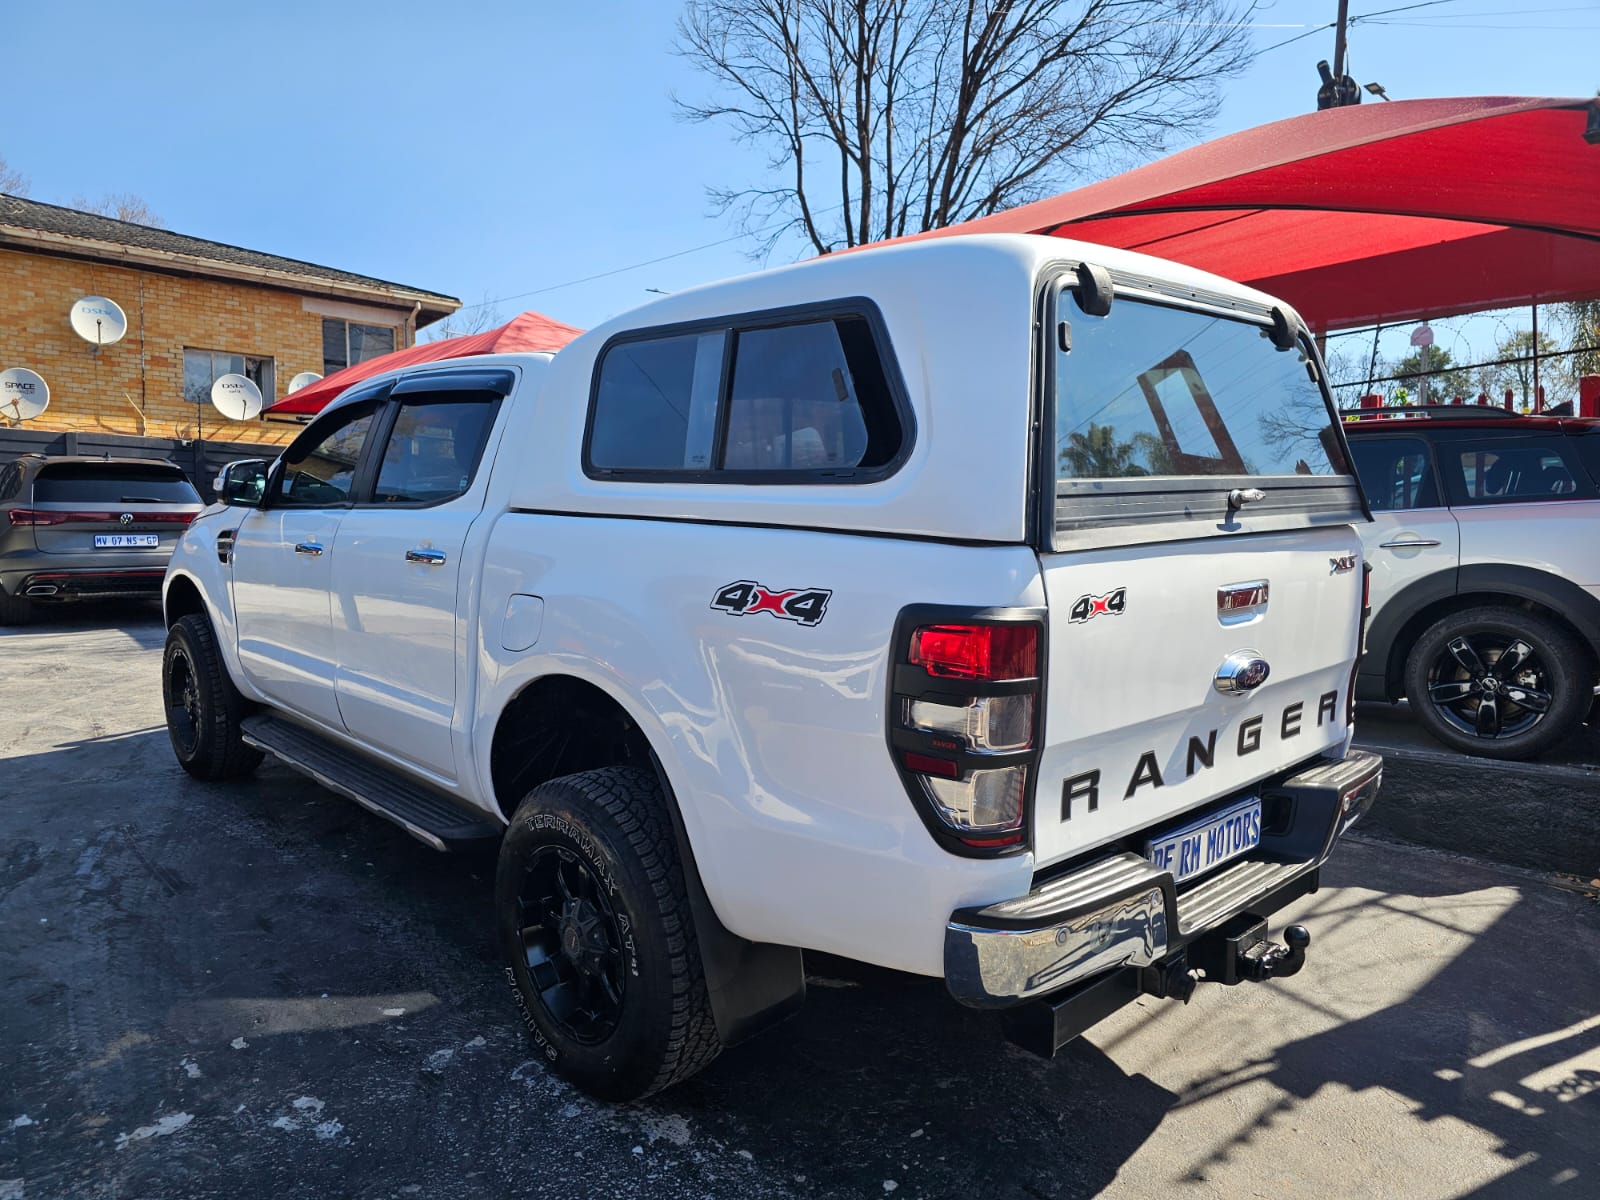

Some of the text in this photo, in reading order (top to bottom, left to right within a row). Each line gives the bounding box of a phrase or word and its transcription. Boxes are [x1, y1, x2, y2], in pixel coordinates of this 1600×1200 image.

[4, 381, 36, 390] SPACE
[1060, 689, 1338, 823] RANGER
[525, 814, 619, 896] TERRAMAX
[1178, 834, 1202, 876] RM
[1206, 808, 1260, 865] MOTORS
